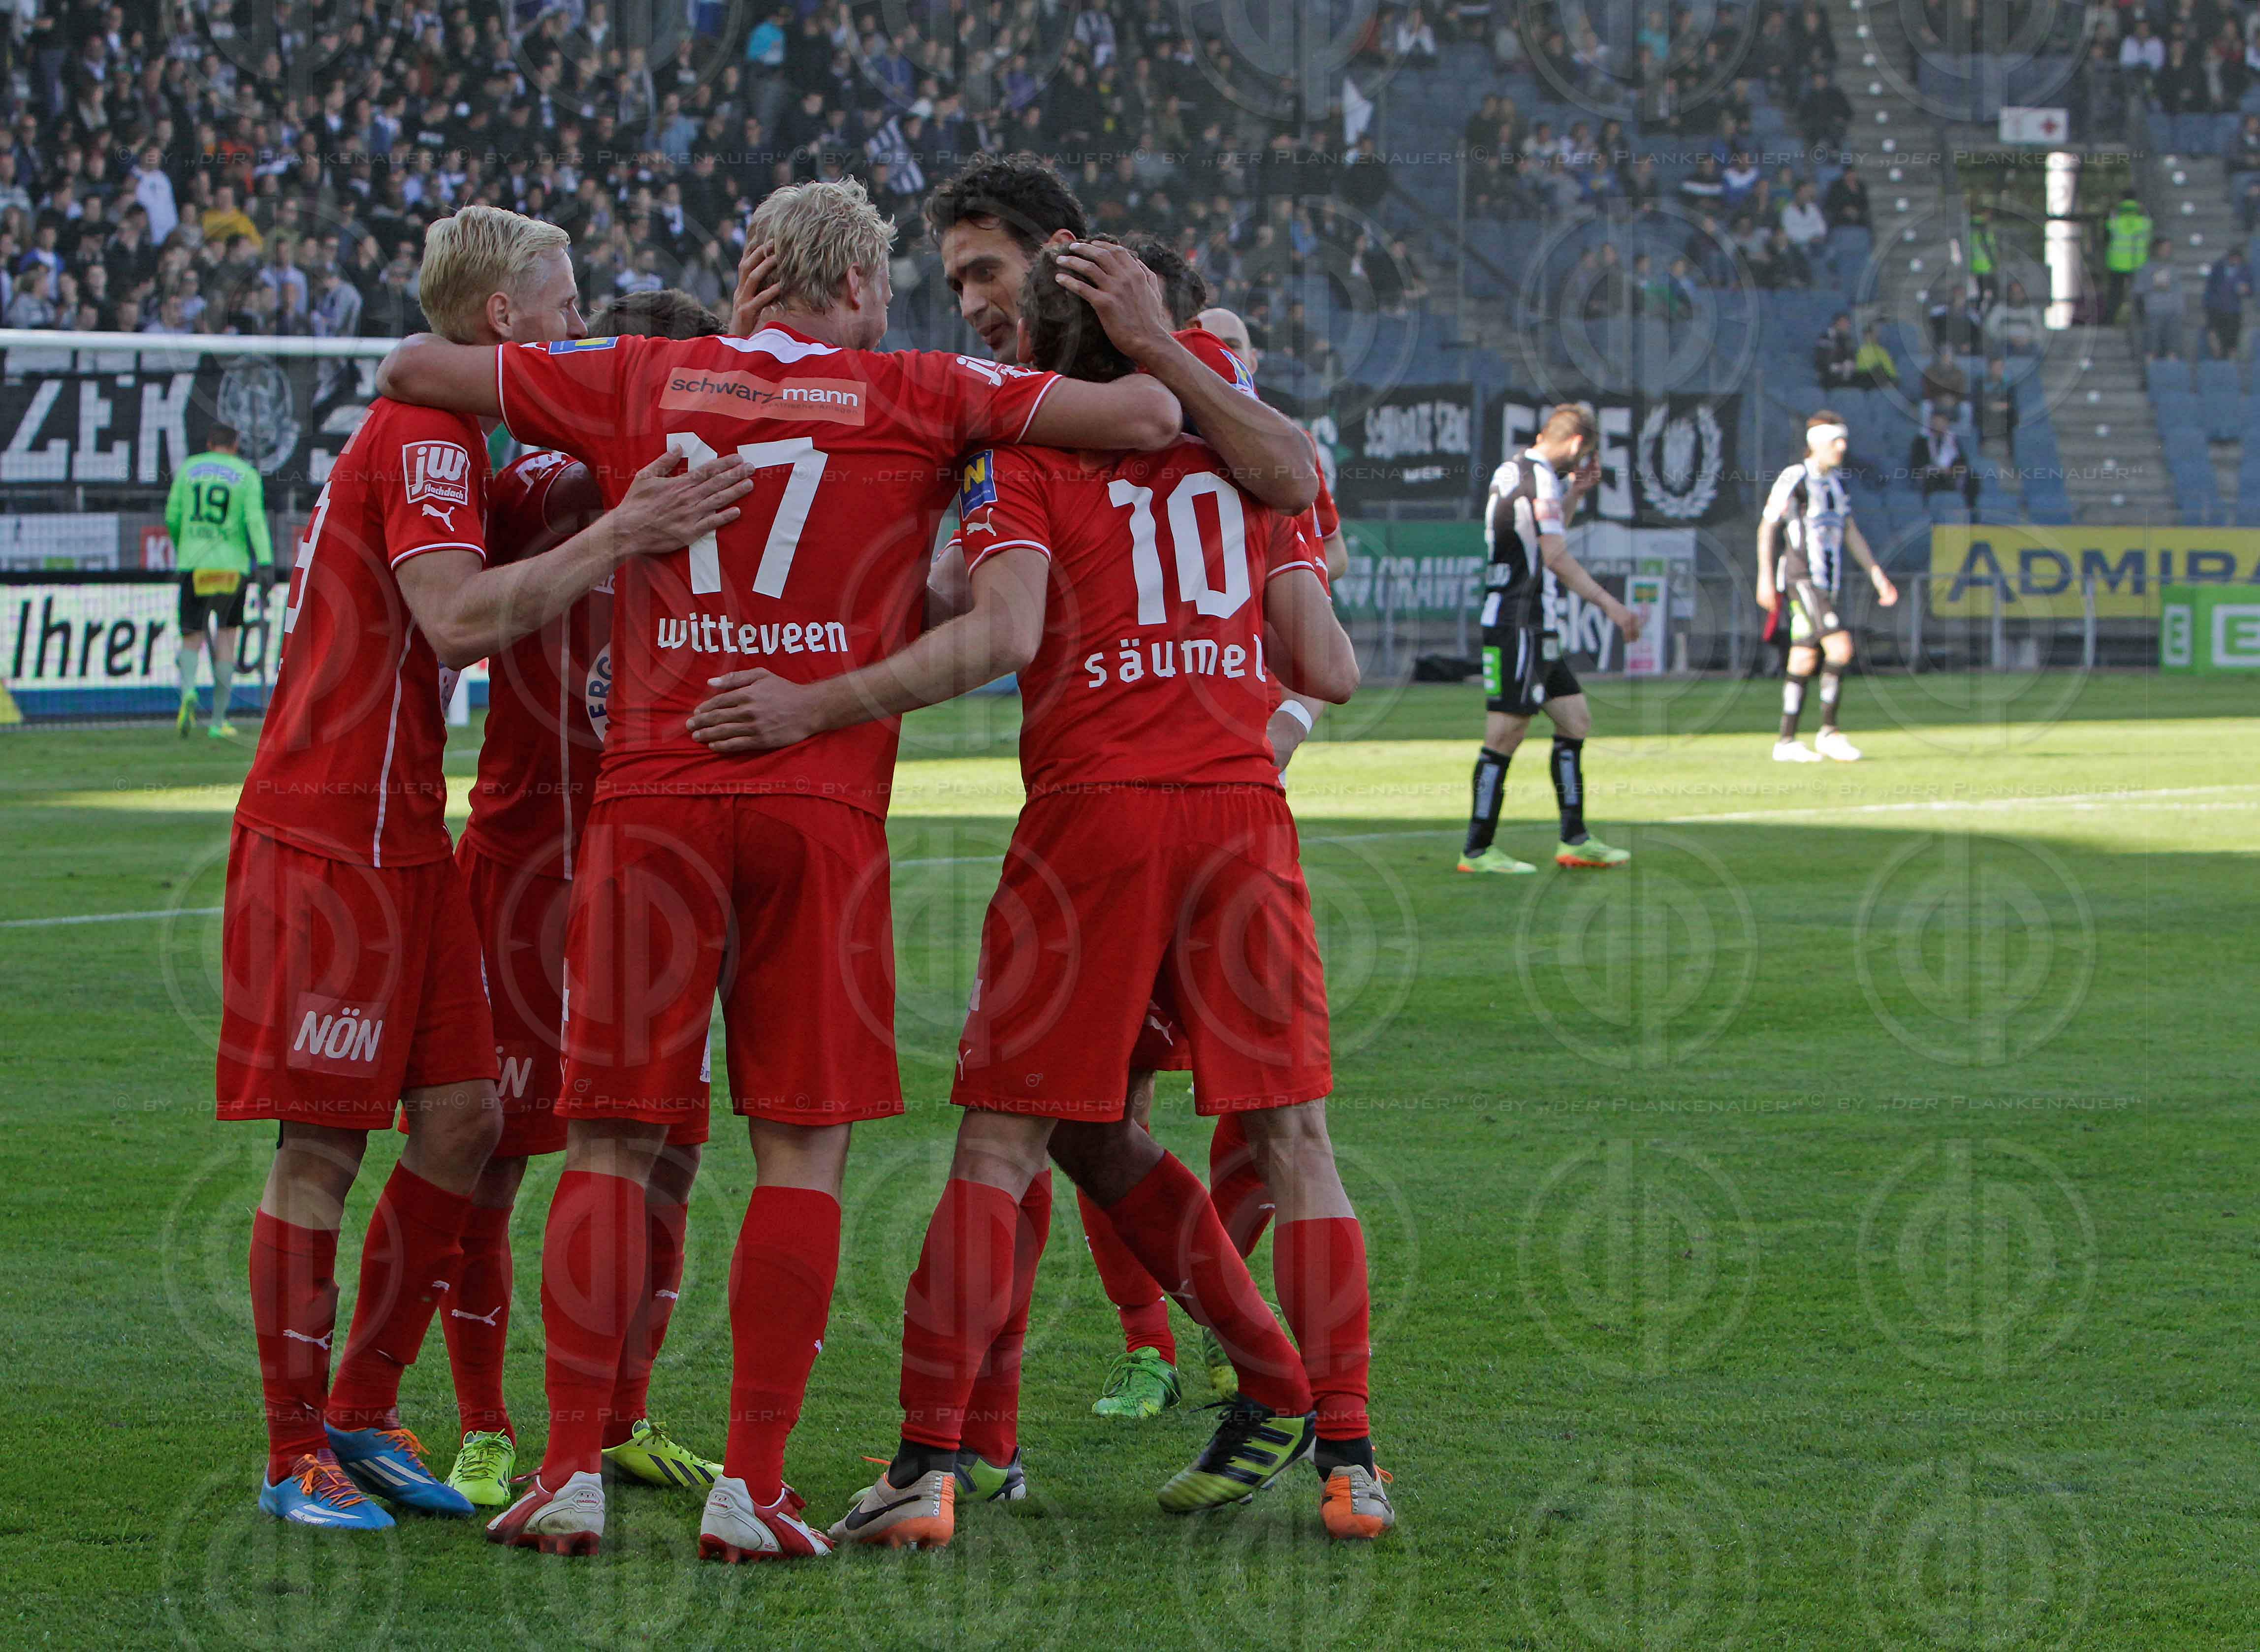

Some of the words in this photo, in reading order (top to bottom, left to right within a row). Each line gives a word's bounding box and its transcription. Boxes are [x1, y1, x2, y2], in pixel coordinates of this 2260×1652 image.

[190, 482, 230, 525] 19
[424, 483, 464, 500] flachdach
[667, 432, 828, 600] 17
[1107, 471, 1251, 626] 10
[1946, 540, 2260, 603] ADMIR
[13, 596, 165, 678] Ihrer
[658, 612, 848, 655] witteveen
[1084, 634, 1267, 688] säumel
[293, 1007, 383, 1062] NÖN
